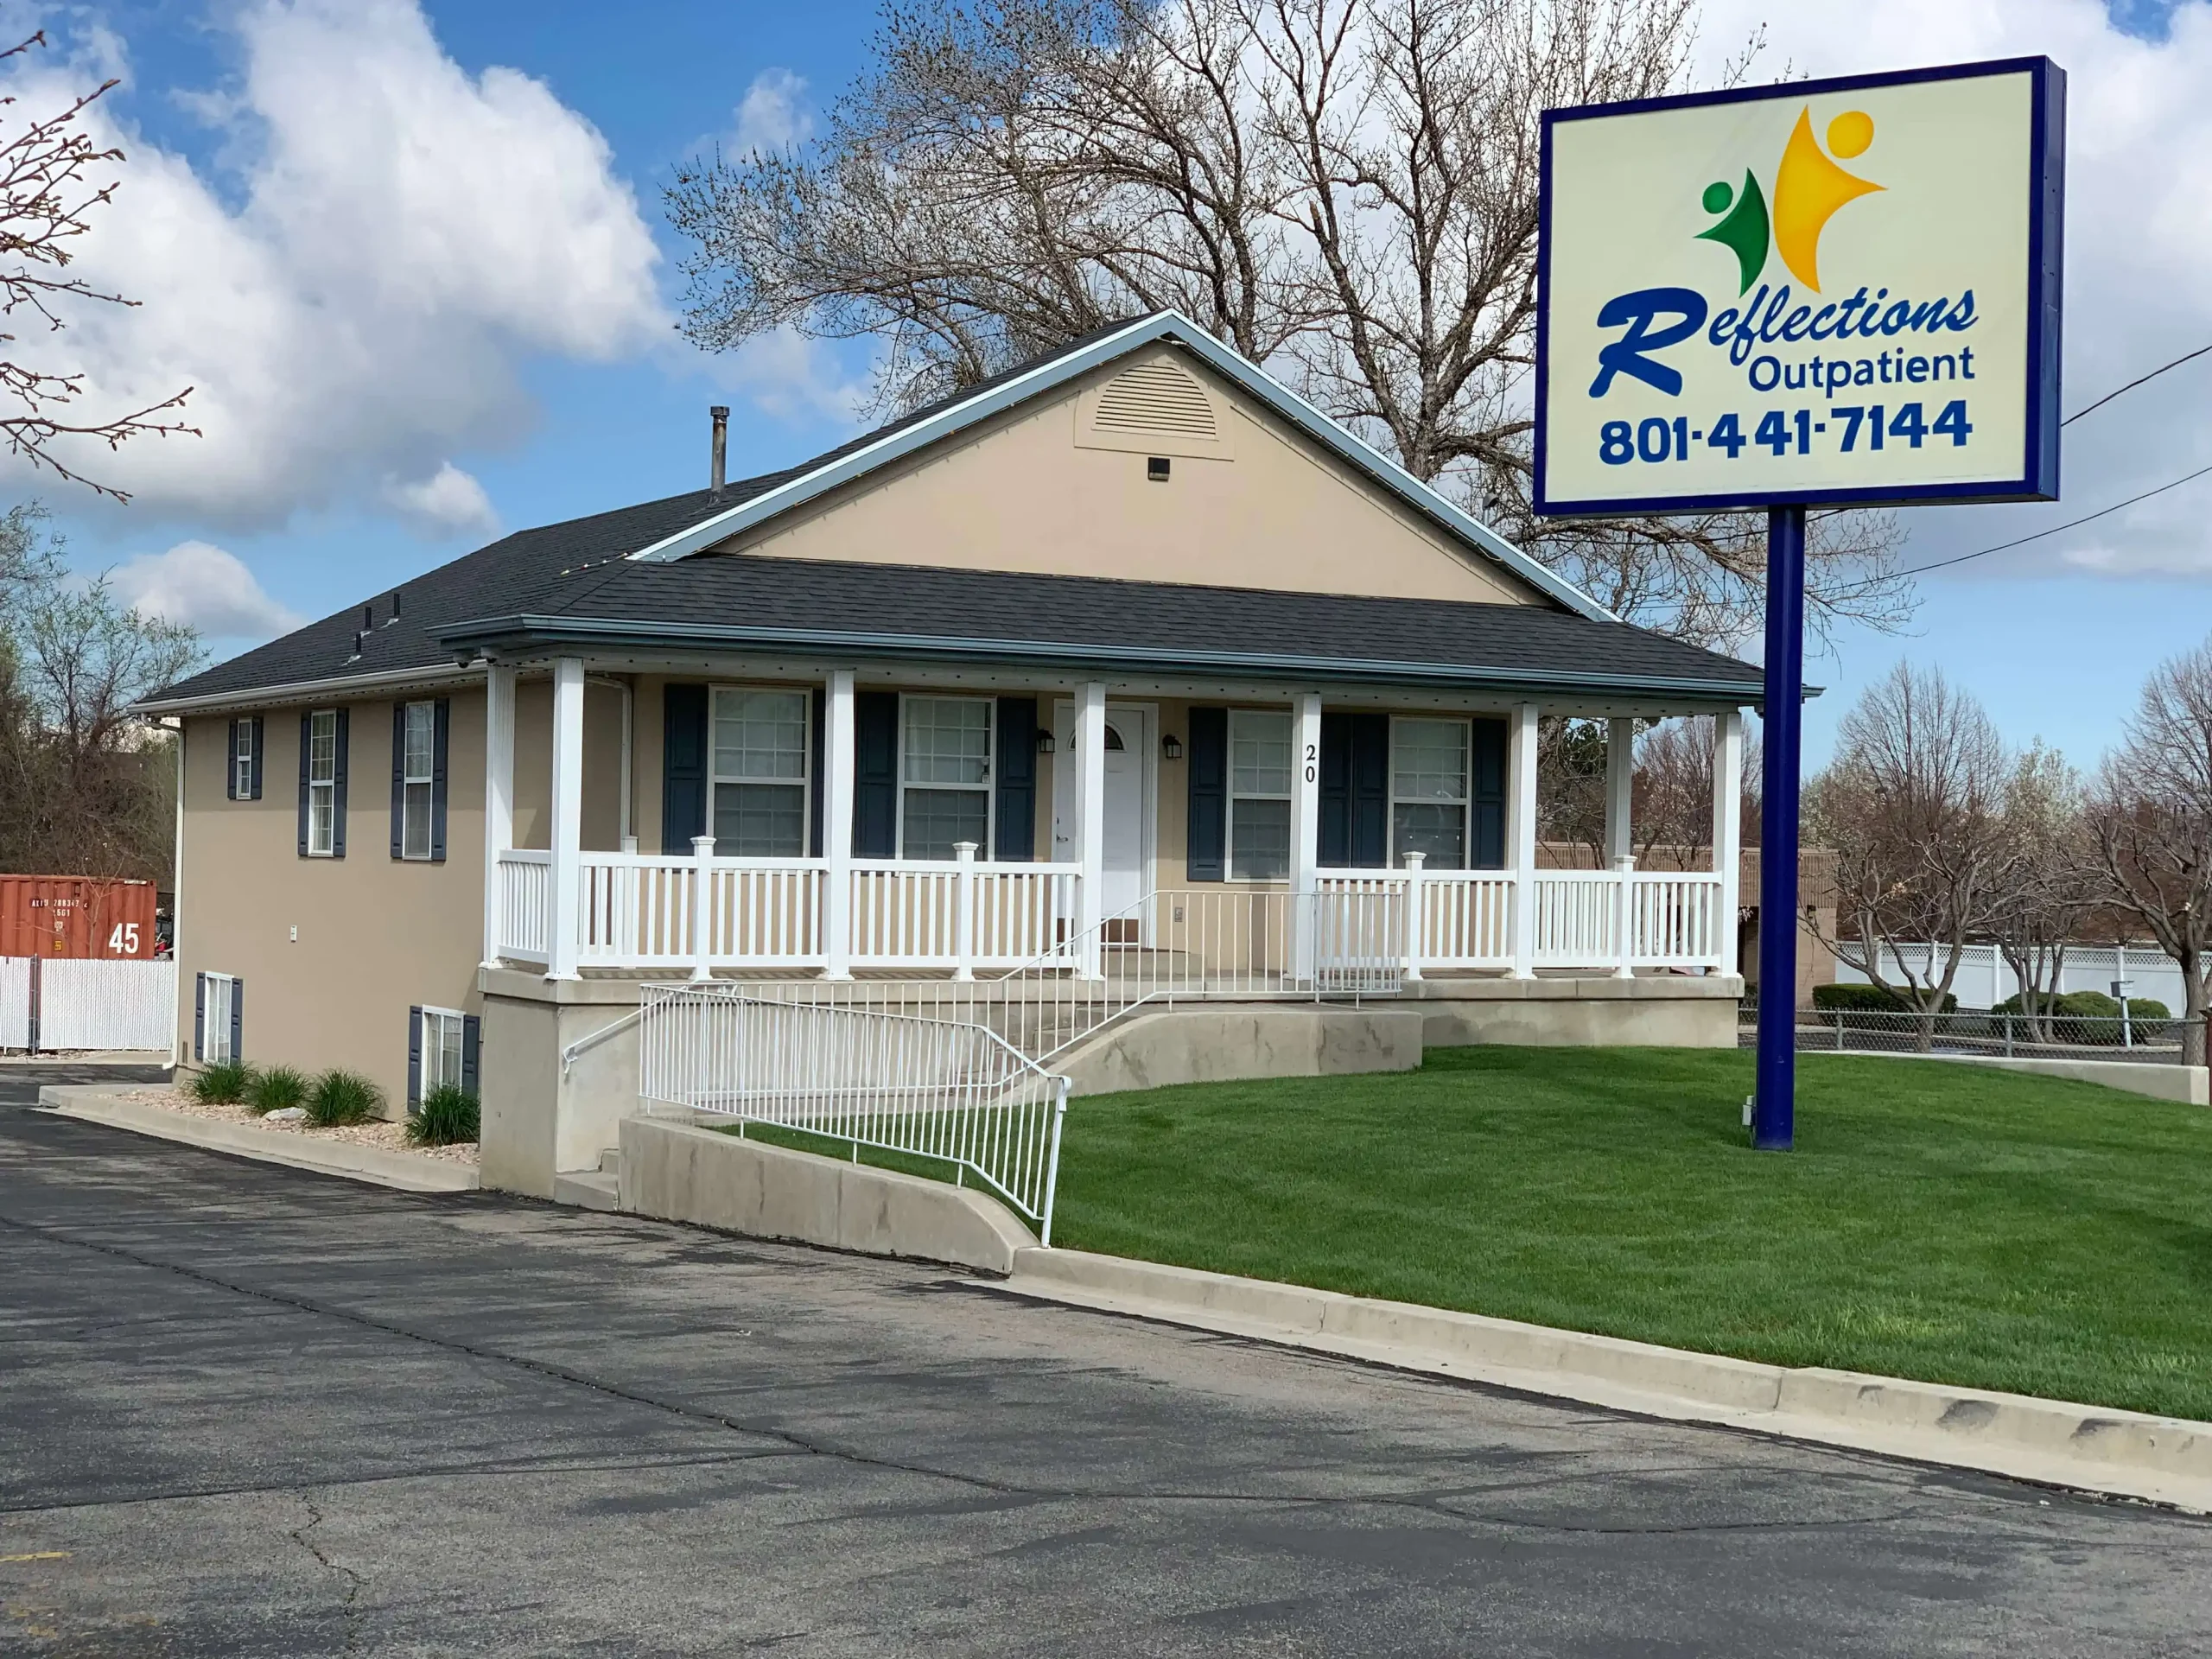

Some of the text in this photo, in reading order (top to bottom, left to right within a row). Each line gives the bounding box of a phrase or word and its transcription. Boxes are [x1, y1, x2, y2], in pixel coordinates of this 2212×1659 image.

[1588, 283, 1979, 398] Reflections
[1748, 346, 1975, 399] Outpatient
[1599, 399, 1974, 466] 801-441-7144
[1306, 744, 1316, 783] 20
[109, 923, 139, 954] 45
